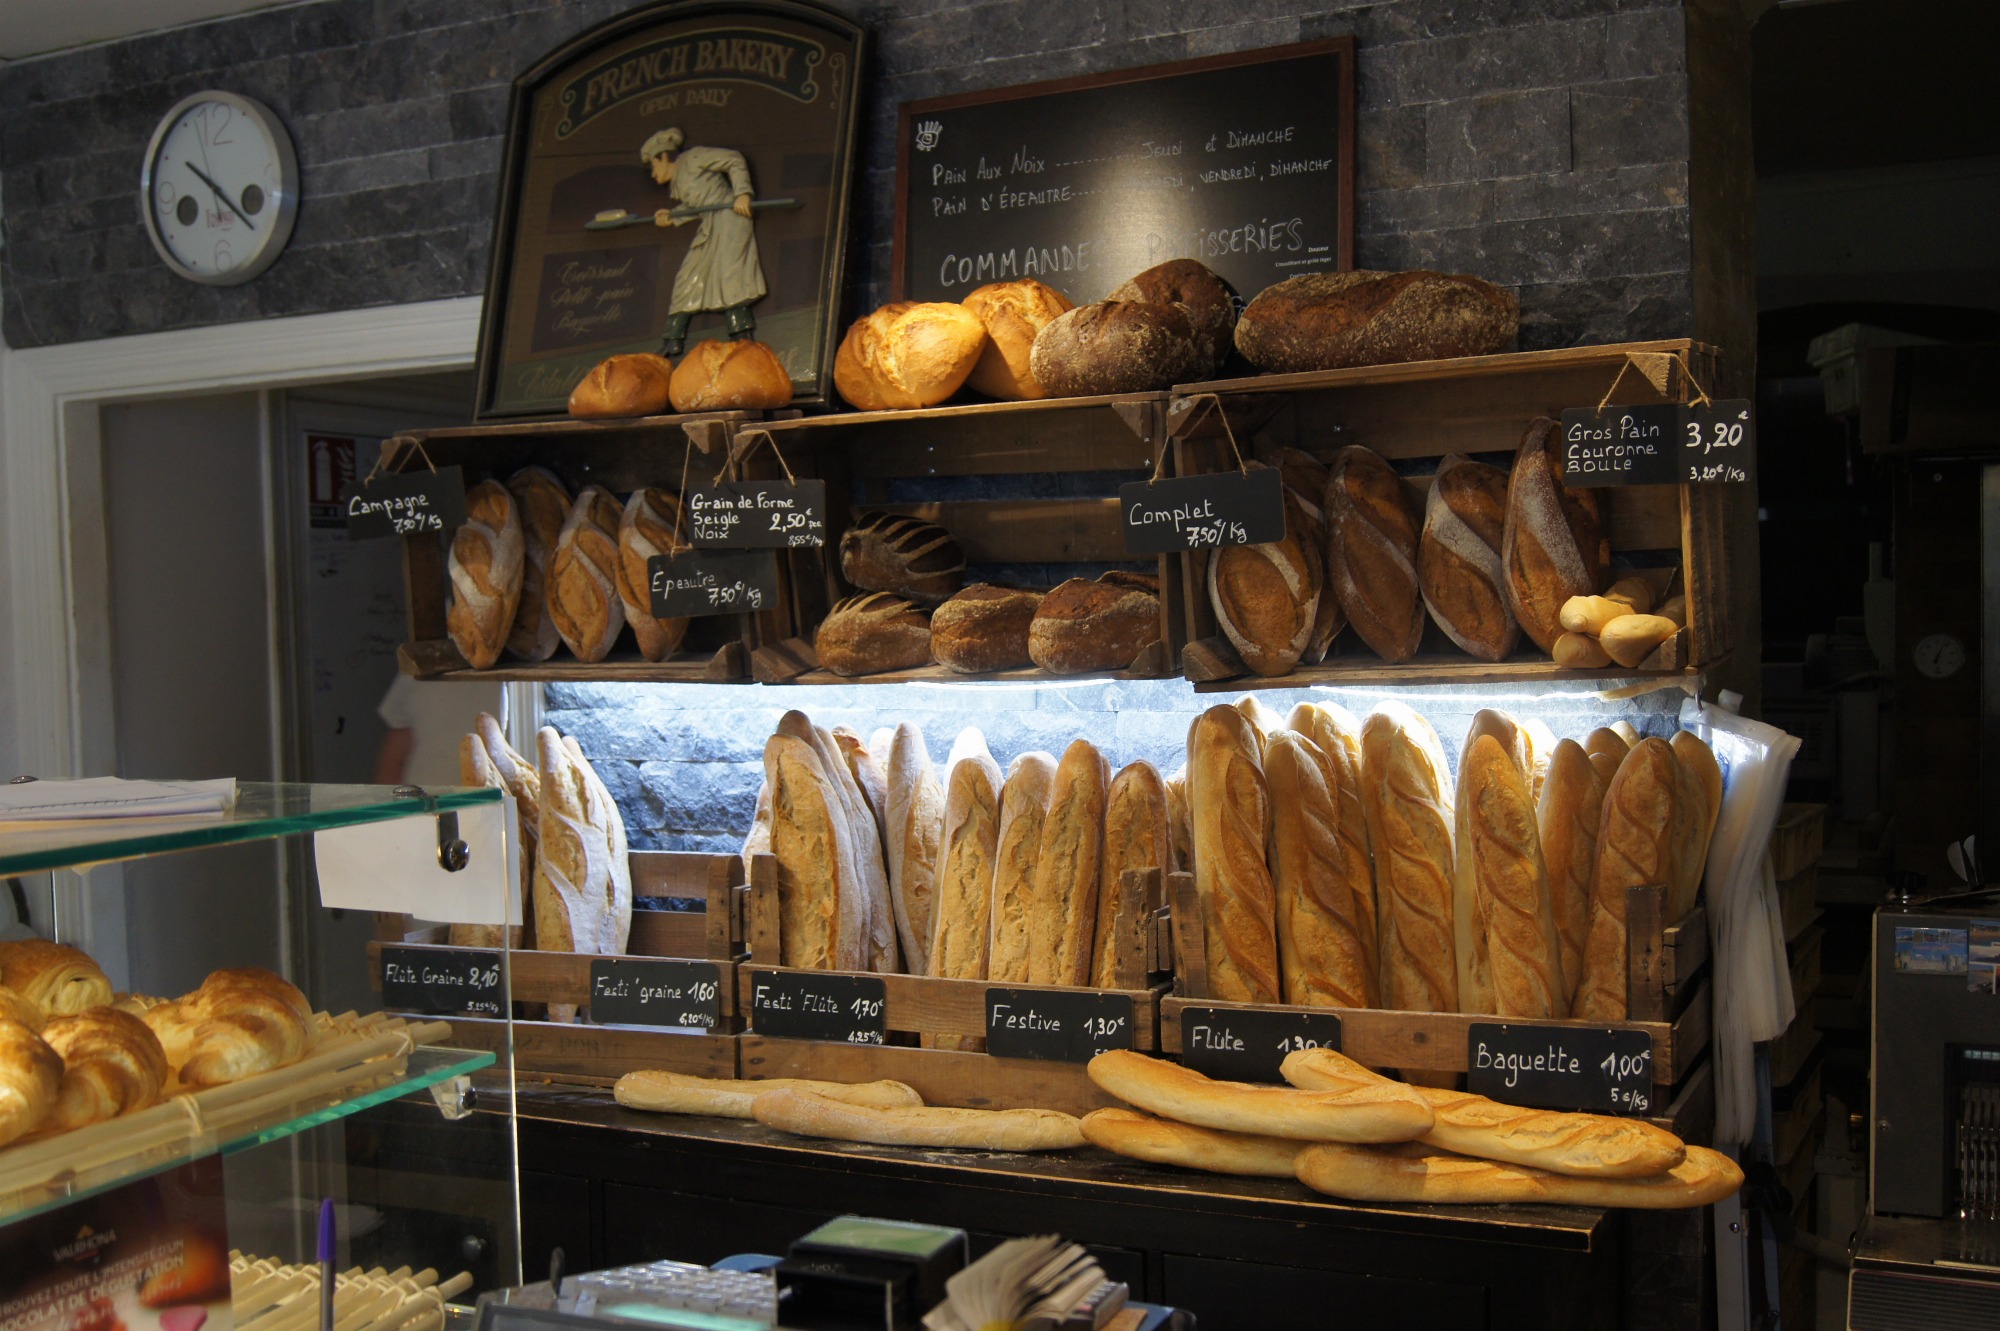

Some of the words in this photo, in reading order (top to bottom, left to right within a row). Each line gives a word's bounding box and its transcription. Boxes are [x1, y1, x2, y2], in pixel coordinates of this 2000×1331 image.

[581, 47, 689, 115] FRENCH
[694, 38, 796, 80] BAKERY
[639, 92, 680, 116] OPEN
[685, 87, 733, 108] DAILY
[196, 102, 234, 147] 12
[1205, 133, 1217, 153] et
[1567, 423, 1613, 442] Gros
[1620, 414, 1660, 440] Pain
[1686, 410, 1749, 455] 3,20€
[1567, 443, 1658, 459] Couronne
[349, 494, 430, 520] Campagne
[691, 493, 734, 511] Grain
[738, 494, 755, 510] de
[757, 491, 795, 510] Forme
[693, 511, 740, 531] Seigle
[768, 507, 813, 533] 2,50€
[1129, 499, 1215, 533] Complet
[694, 526, 730, 540] Noix
[422, 966, 464, 986] Graine
[991, 1003, 1062, 1032] Festive
[1192, 1025, 1246, 1052] Flûte
[1476, 1042, 1581, 1088] Baguette
[1600, 1050, 1651, 1082] 1,00€
